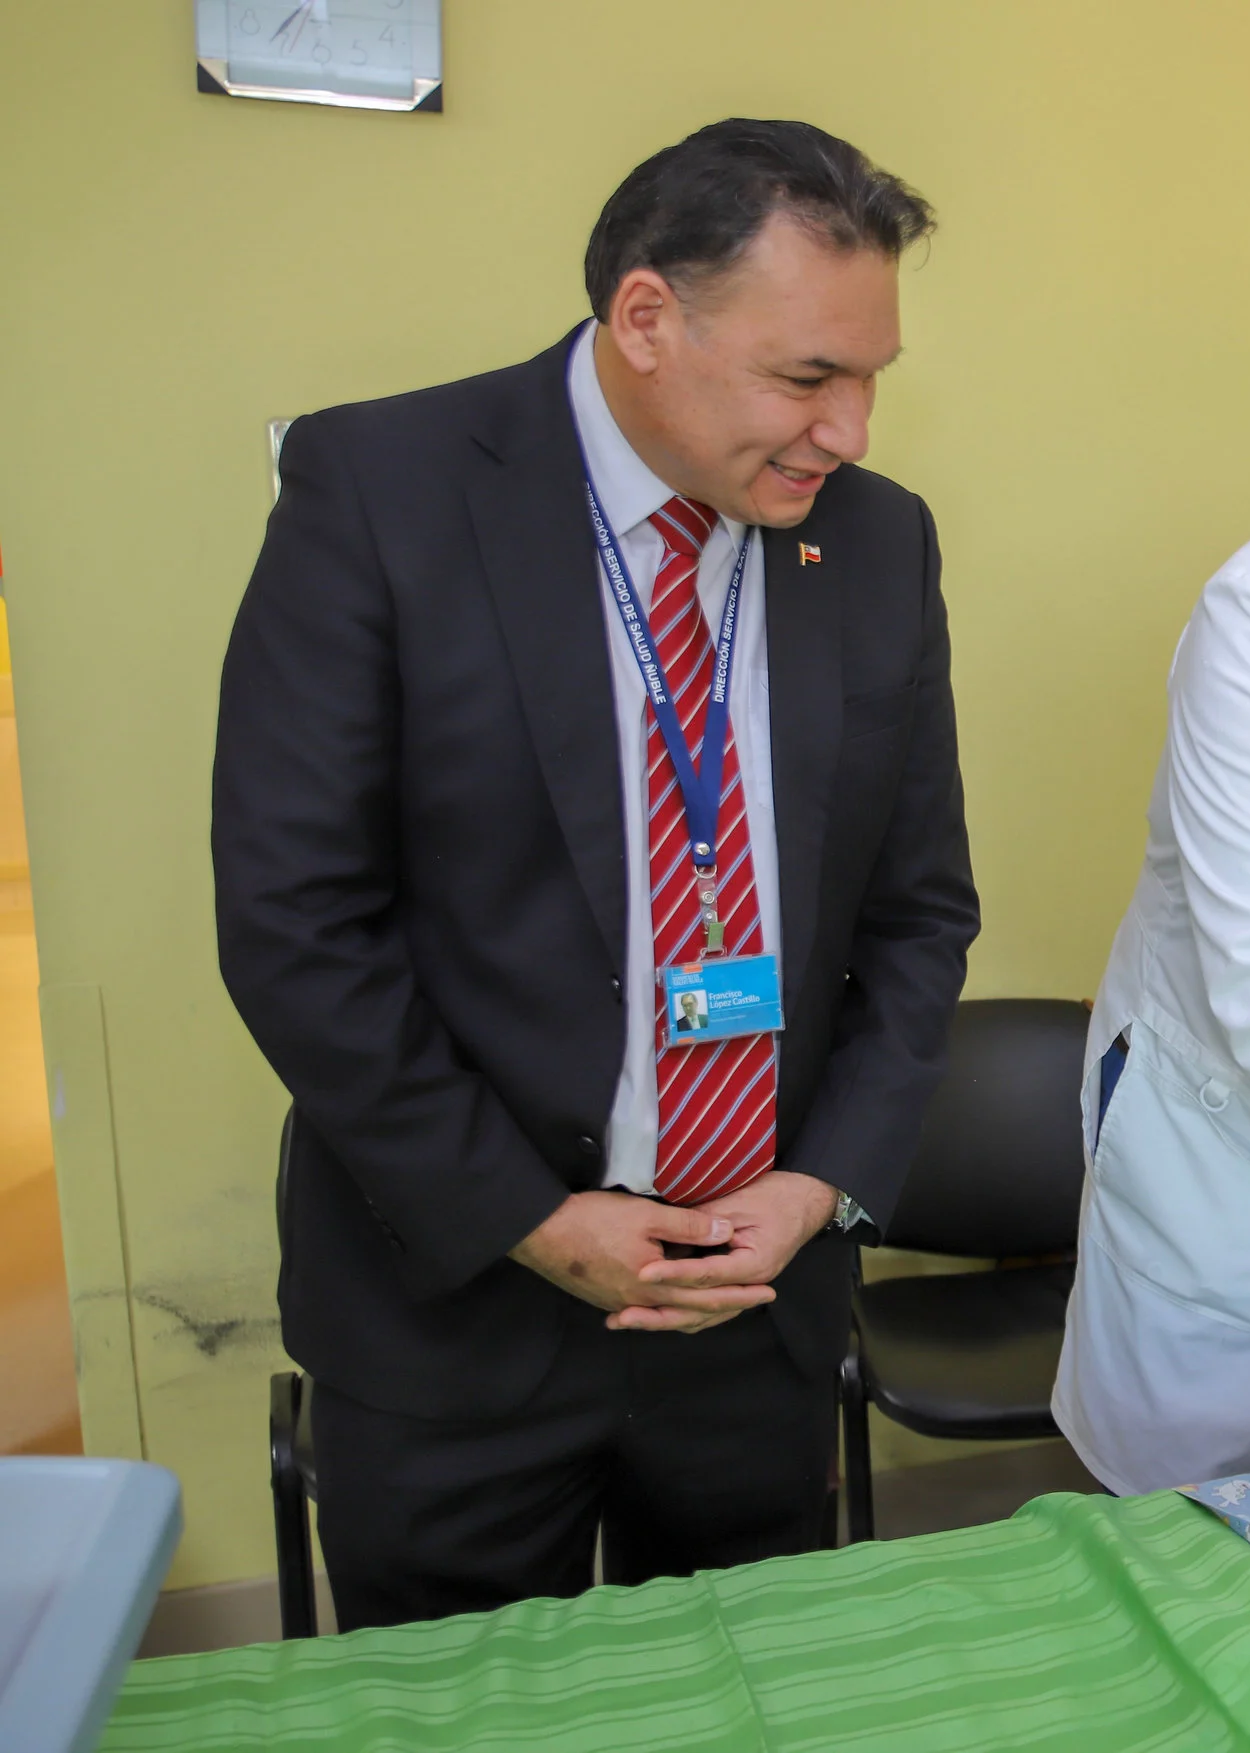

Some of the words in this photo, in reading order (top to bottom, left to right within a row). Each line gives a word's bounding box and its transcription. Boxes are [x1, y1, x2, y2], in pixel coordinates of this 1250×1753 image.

[604, 547, 631, 603] SERVICIO
[623, 603, 638, 622] DE
[630, 623, 652, 662] SALUD
[714, 641, 731, 703] DIRECCIÓN
[723, 588, 737, 641] SERVICIO
[732, 571, 741, 588] DE
[645, 664, 667, 705] ÑUBLE
[708, 990, 743, 1001] Francisco
[732, 994, 761, 1006] Castillo
